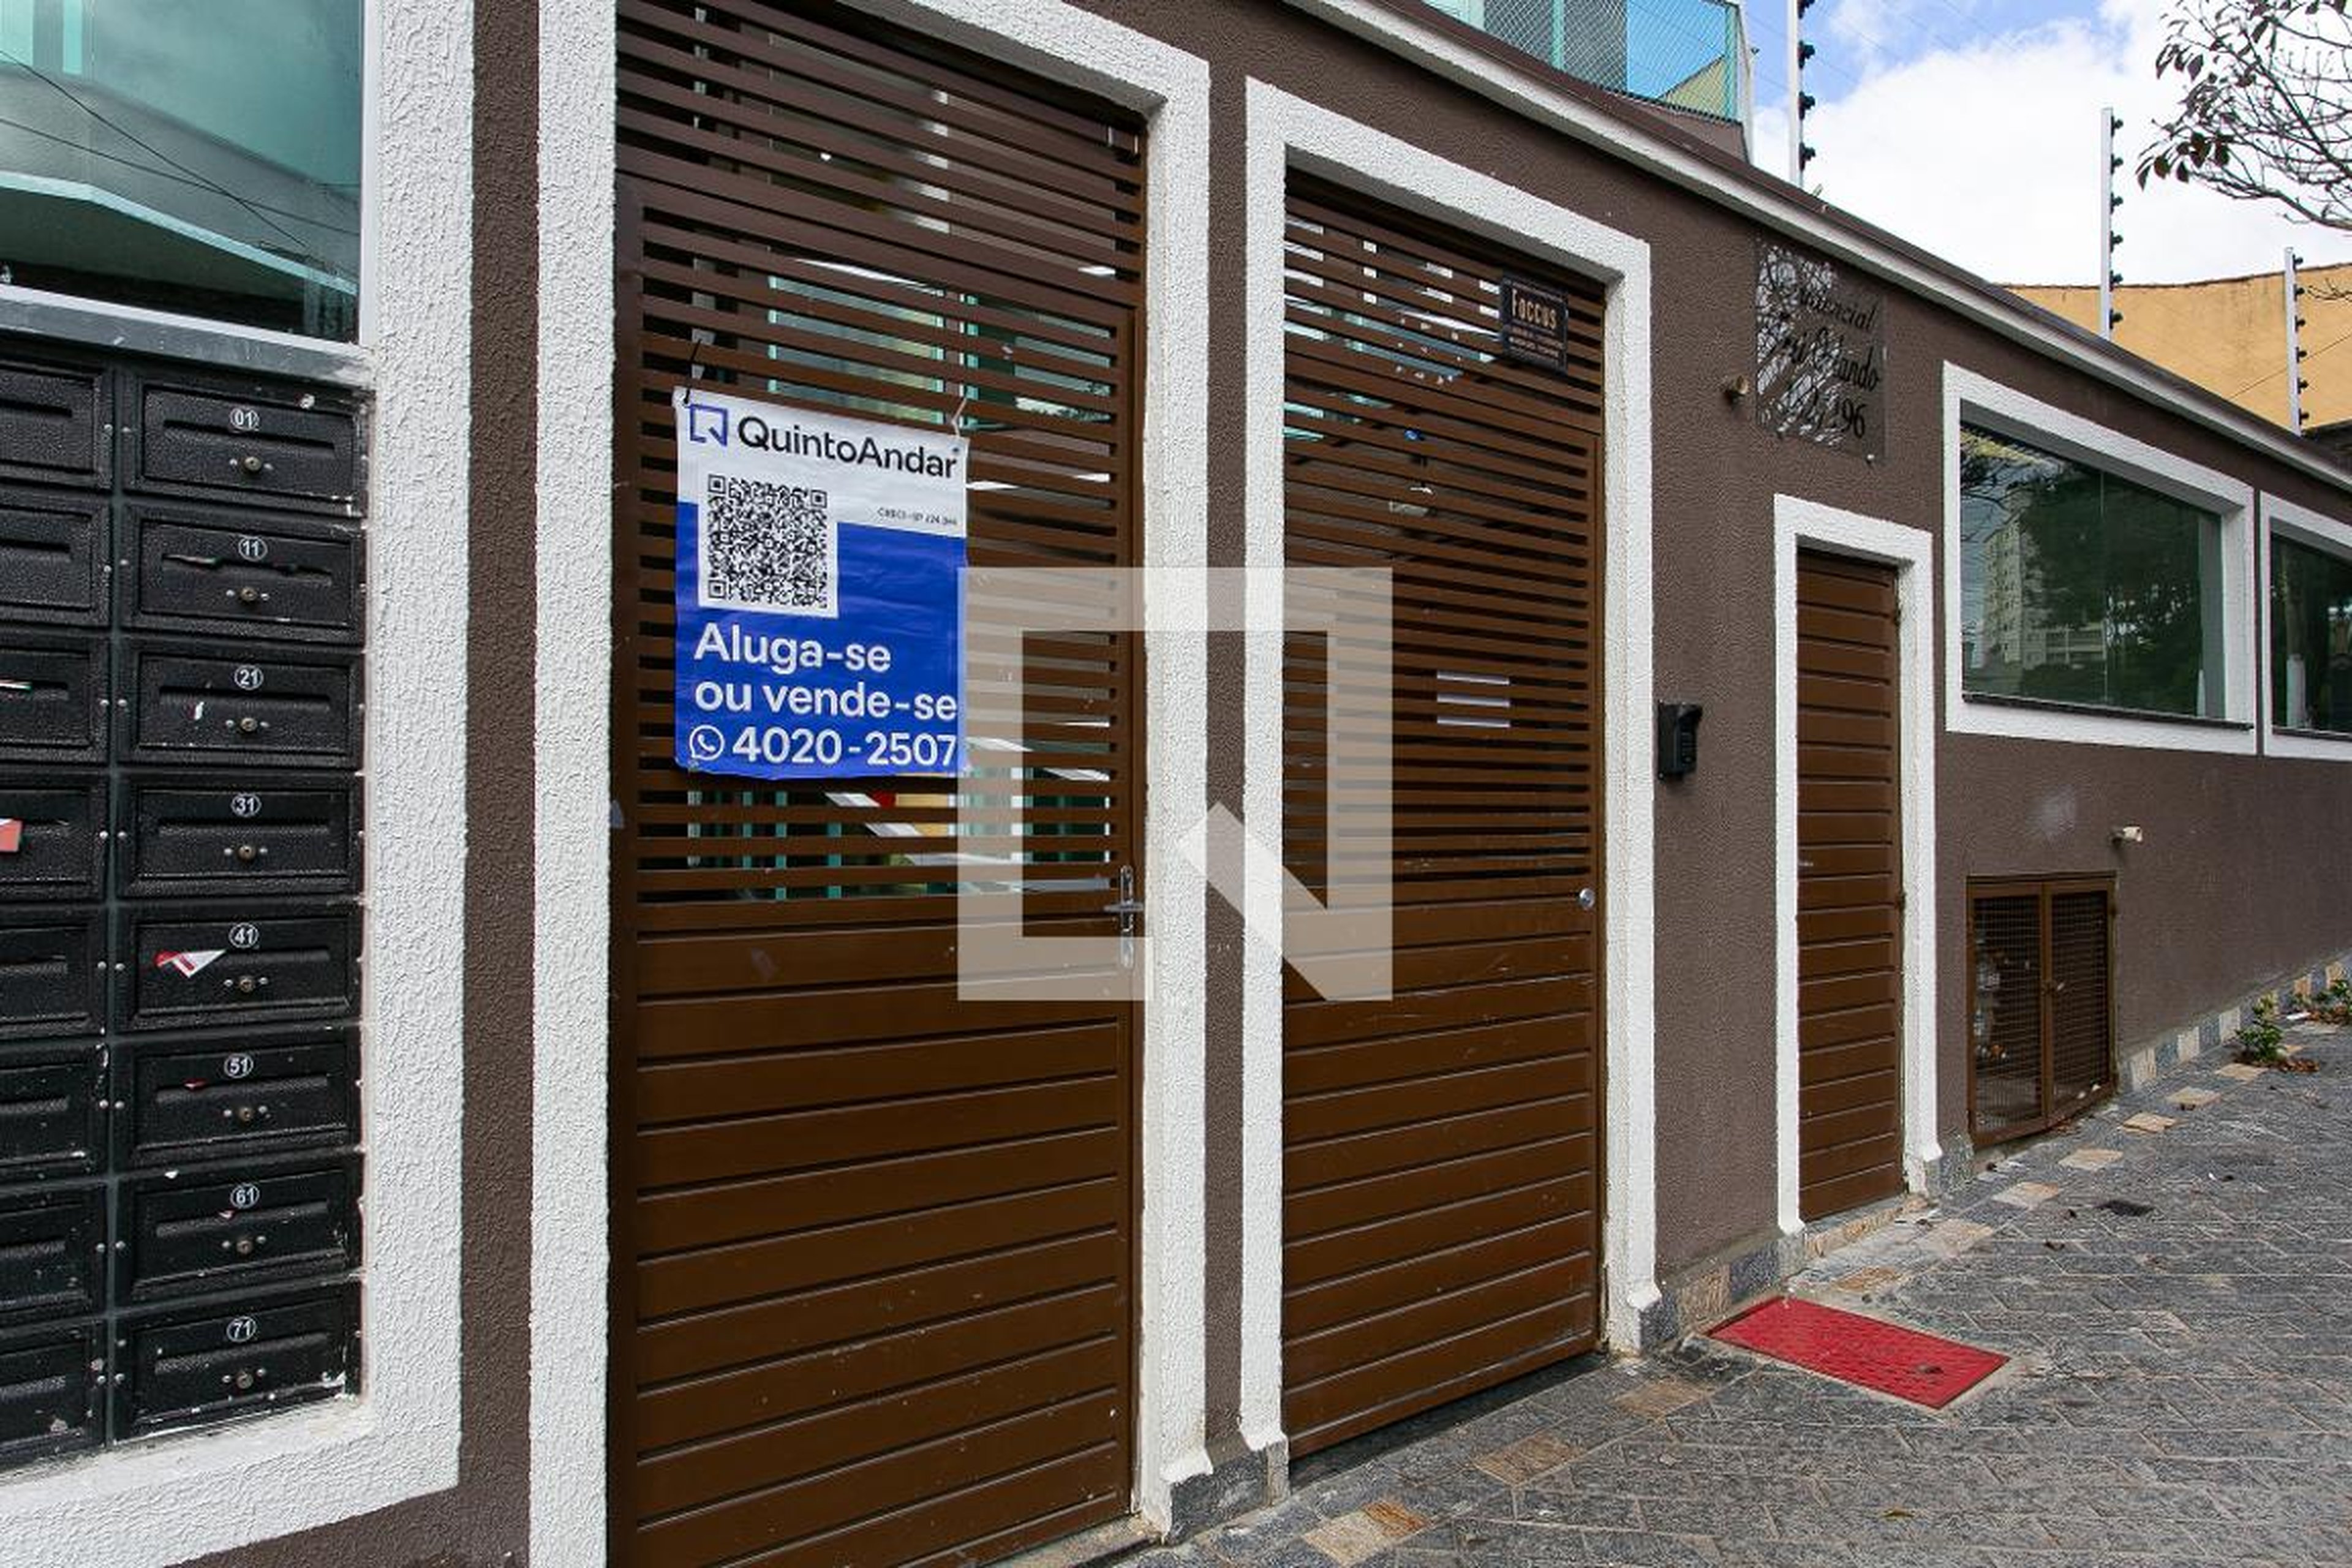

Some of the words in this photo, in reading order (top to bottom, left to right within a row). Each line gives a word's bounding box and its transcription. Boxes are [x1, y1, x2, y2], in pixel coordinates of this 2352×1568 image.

[235, 409, 253, 426] 01
[738, 416, 957, 478] QuintoAndar
[243, 540, 259, 556] 11
[693, 622, 891, 675] Aluga-se
[239, 670, 258, 685] 21
[695, 680, 752, 712] ou
[763, 681, 957, 721] vende-se
[733, 726, 957, 767] 4020-2507
[236, 797, 255, 813] 31
[235, 928, 254, 944] 41
[230, 1058, 249, 1074] 51
[236, 1188, 255, 1204] 61
[233, 1320, 252, 1338] 71
